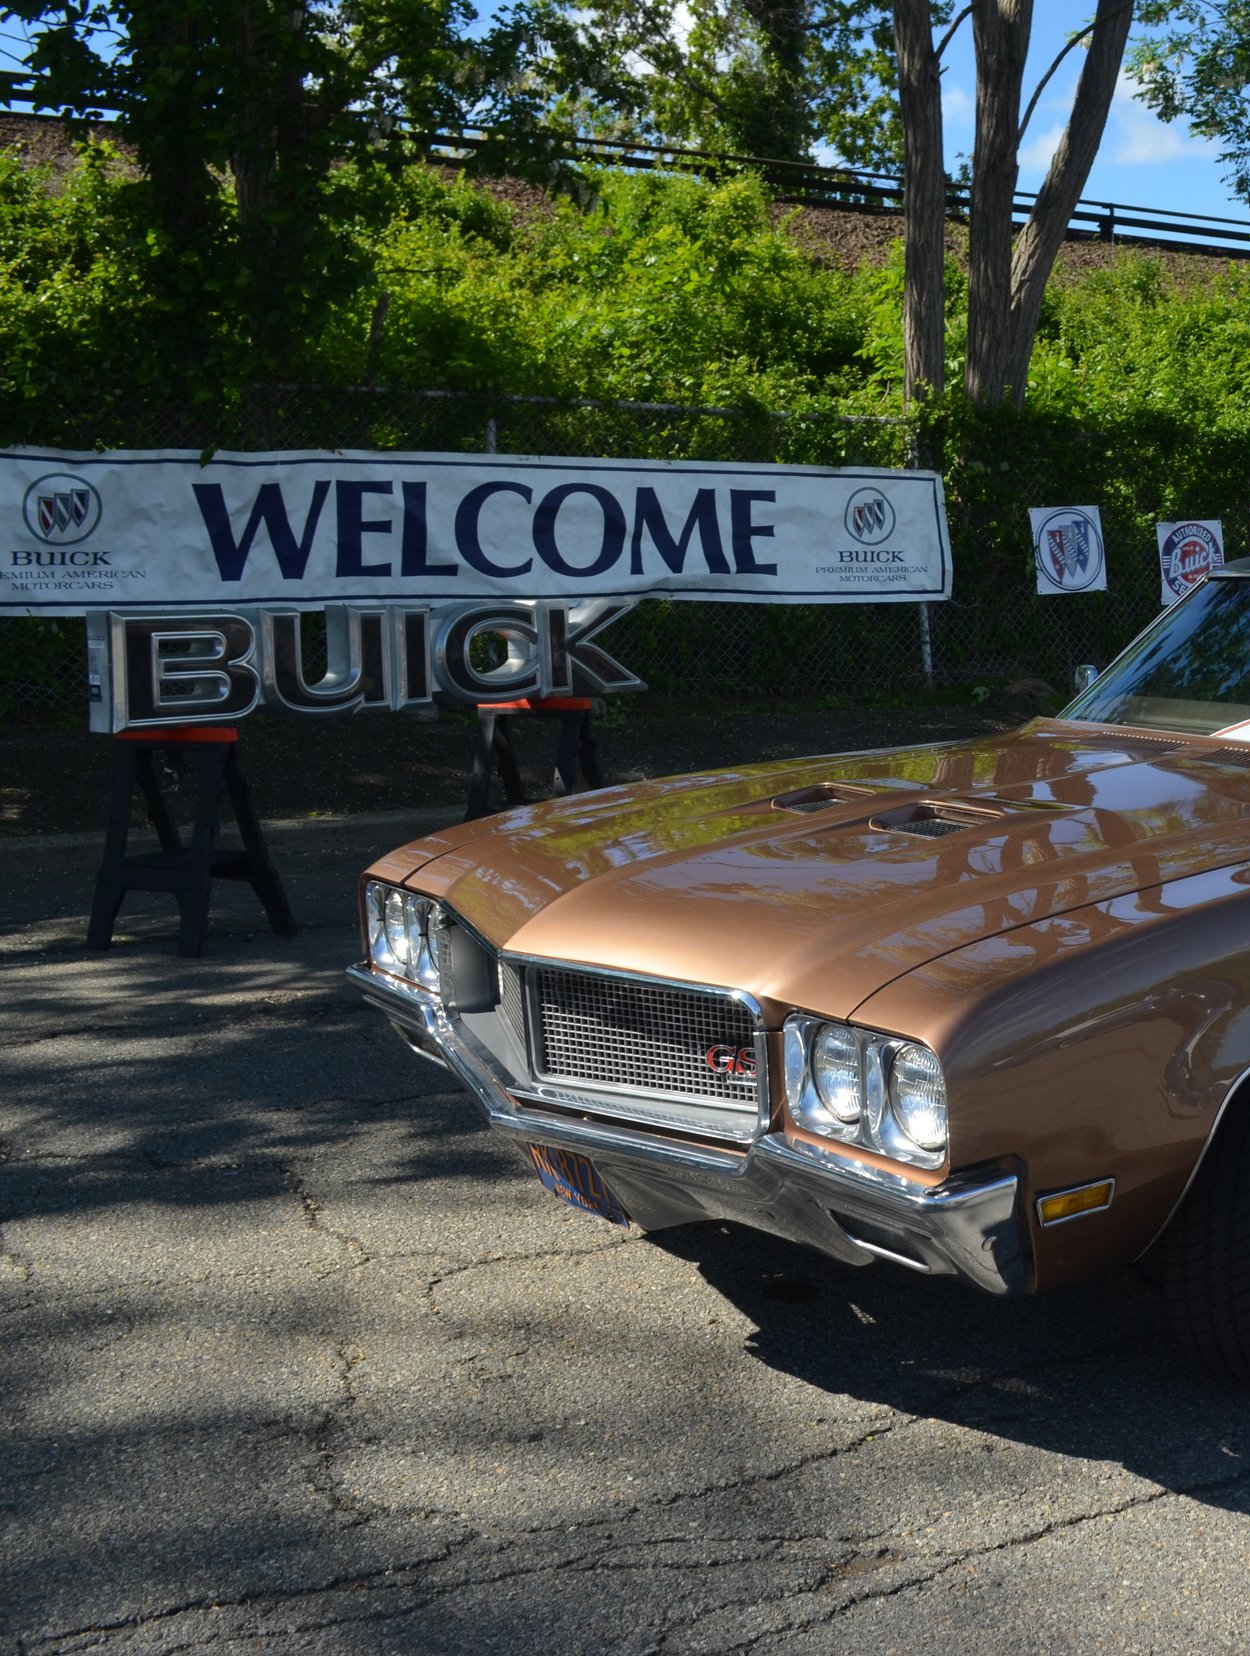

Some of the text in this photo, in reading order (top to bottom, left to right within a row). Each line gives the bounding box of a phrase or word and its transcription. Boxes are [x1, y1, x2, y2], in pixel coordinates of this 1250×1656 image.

[191, 479, 778, 582] WELCOME
[1172, 525, 1211, 544] AUTHORIZED
[10, 550, 112, 567] BUICK
[837, 550, 905, 563] BUICK
[1169, 542, 1217, 578] Buick
[0, 570, 146, 579] EMIUM AMERICAN
[815, 565, 928, 574] PREMIUM AMERICAN
[839, 574, 906, 582] MOTORCARS
[11, 581, 114, 590] MOTORCARS
[106, 600, 649, 734] BUICK
[706, 1044, 758, 1077] GS
